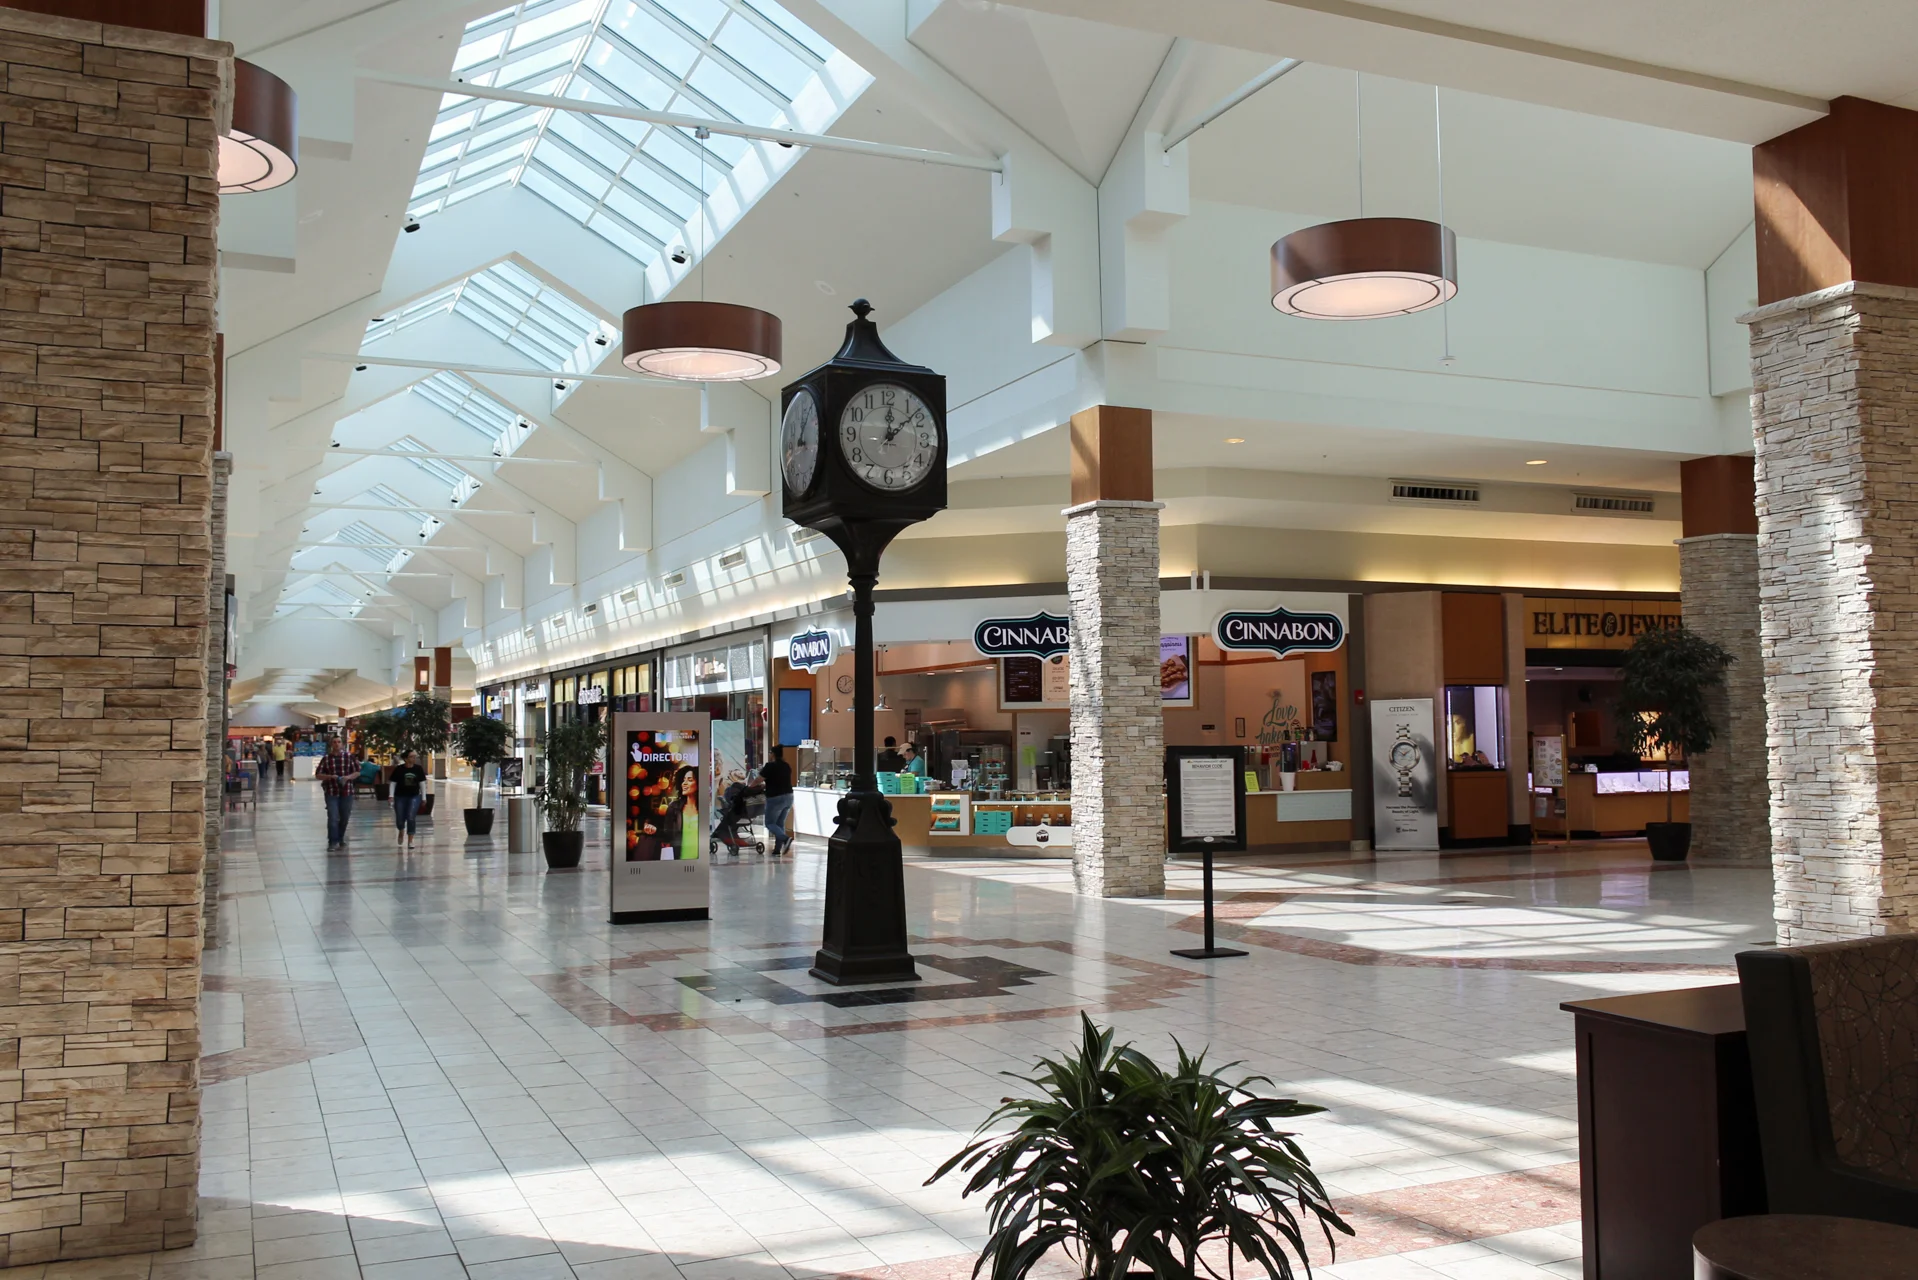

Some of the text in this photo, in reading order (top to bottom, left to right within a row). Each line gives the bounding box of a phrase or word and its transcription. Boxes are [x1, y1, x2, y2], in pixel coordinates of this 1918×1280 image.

[864, 394, 874, 409] 11
[881, 390, 896, 406] 12
[904, 398, 910, 414] 1
[850, 407, 863, 422] 10
[914, 412, 925, 428] 2
[846, 426, 857, 443] 9
[919, 432, 930, 449] 3
[852, 447, 862, 463] 8
[913, 453, 924, 467] 4
[865, 463, 875, 479] 7
[883, 469, 894, 485] 6
[901, 465, 912, 481] 5
[1226, 619, 1332, 641] CINNABON
[1532, 611, 1600, 636] ELITE
[1617, 613, 1683, 636] JEWE
[791, 638, 828, 661] CINNABON
[1263, 698, 1298, 727] Love
[642, 752, 694, 763] DIRECTORY
